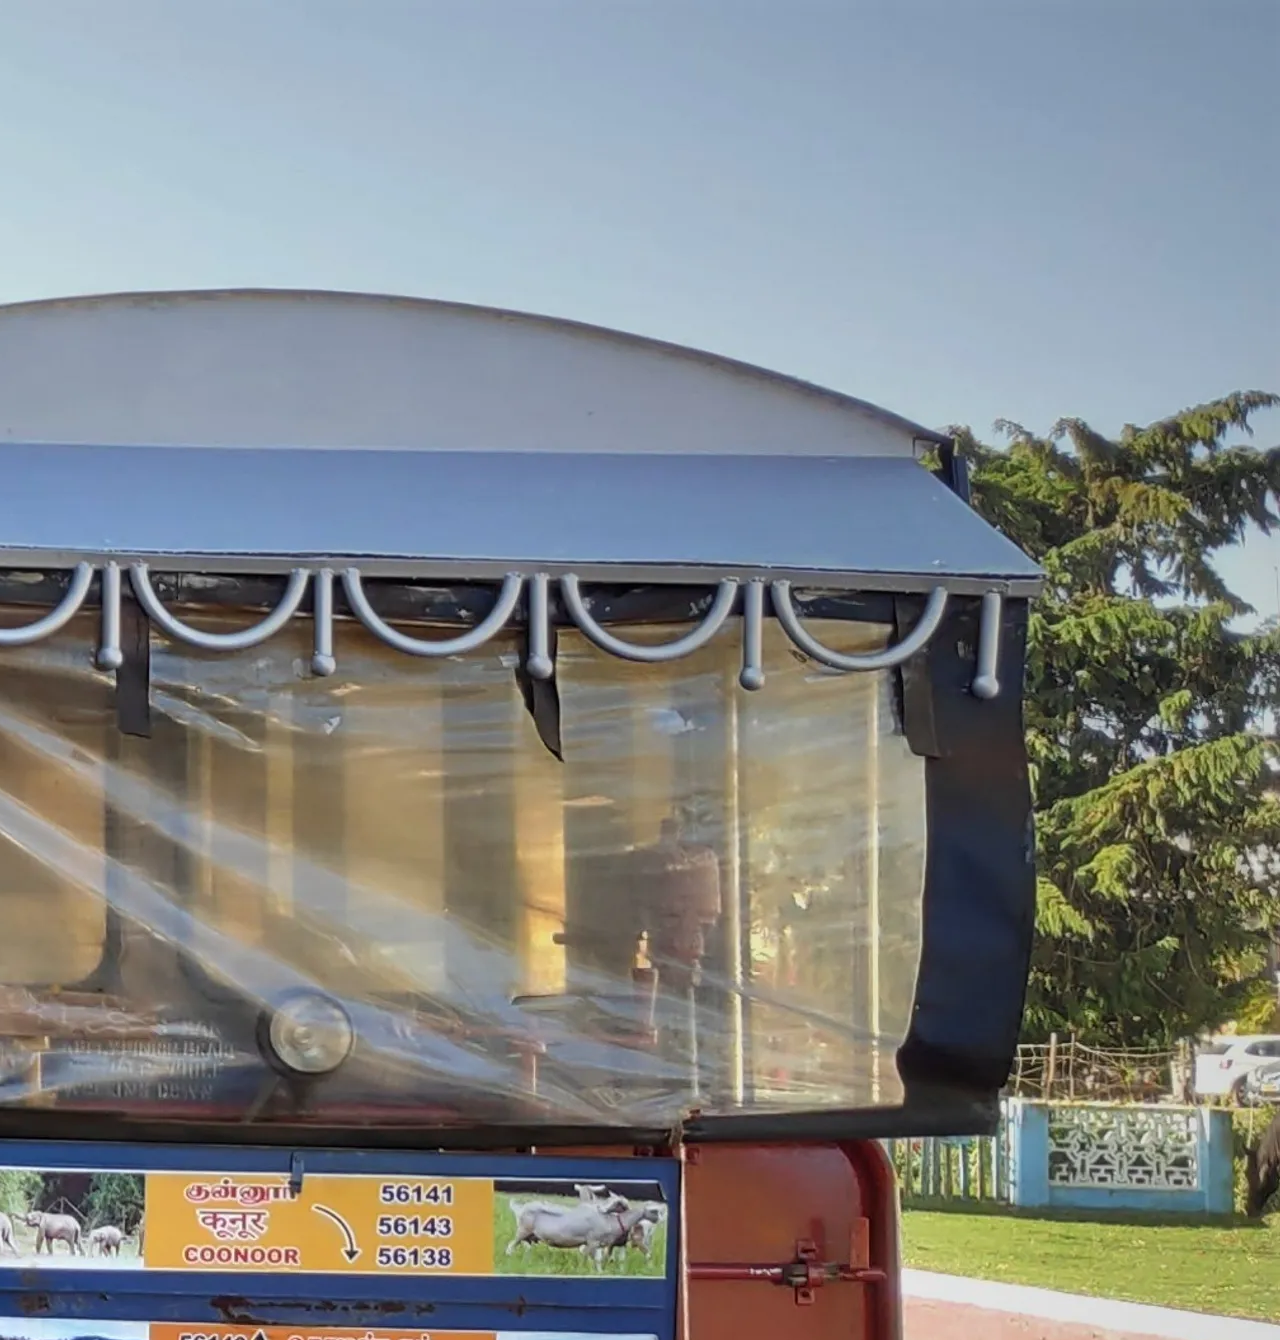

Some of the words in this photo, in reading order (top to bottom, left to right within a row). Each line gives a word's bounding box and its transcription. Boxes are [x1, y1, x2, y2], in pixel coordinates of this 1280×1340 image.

[381, 1184, 453, 1204] 56141
[198, 1209, 268, 1239] कूनूर
[378, 1216, 452, 1236] 56143
[183, 1245, 300, 1264] COONOOR
[377, 1247, 452, 1266] 56138
